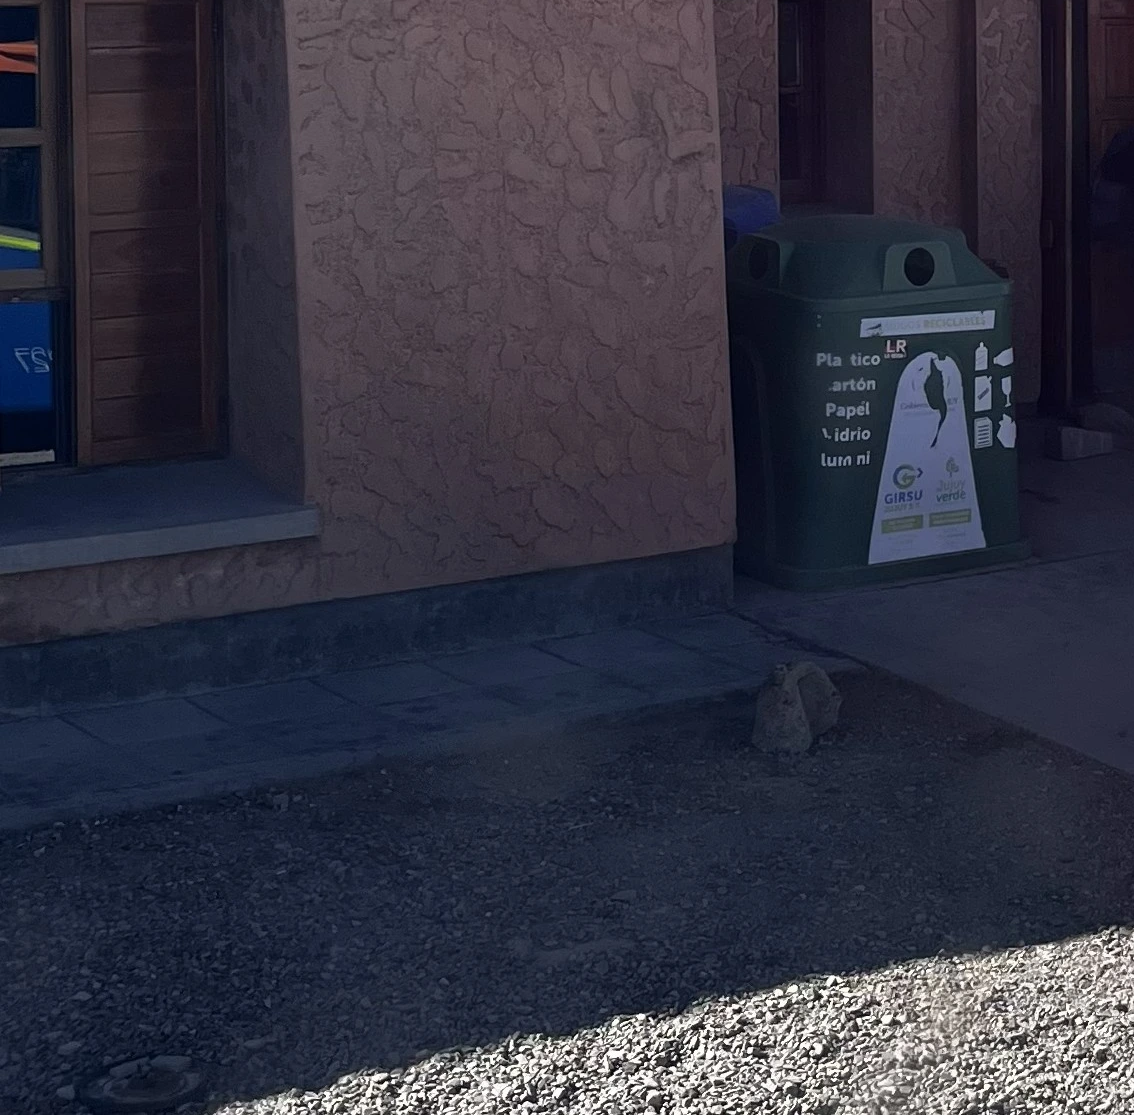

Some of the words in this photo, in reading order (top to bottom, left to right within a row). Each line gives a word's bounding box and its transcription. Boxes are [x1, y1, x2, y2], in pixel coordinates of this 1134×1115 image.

[886, 339, 907, 353] LR
[816, 352, 881, 367] Platico
[828, 377, 876, 392] artón
[884, 490, 923, 504] GIRSU
[936, 490, 967, 502] verde
